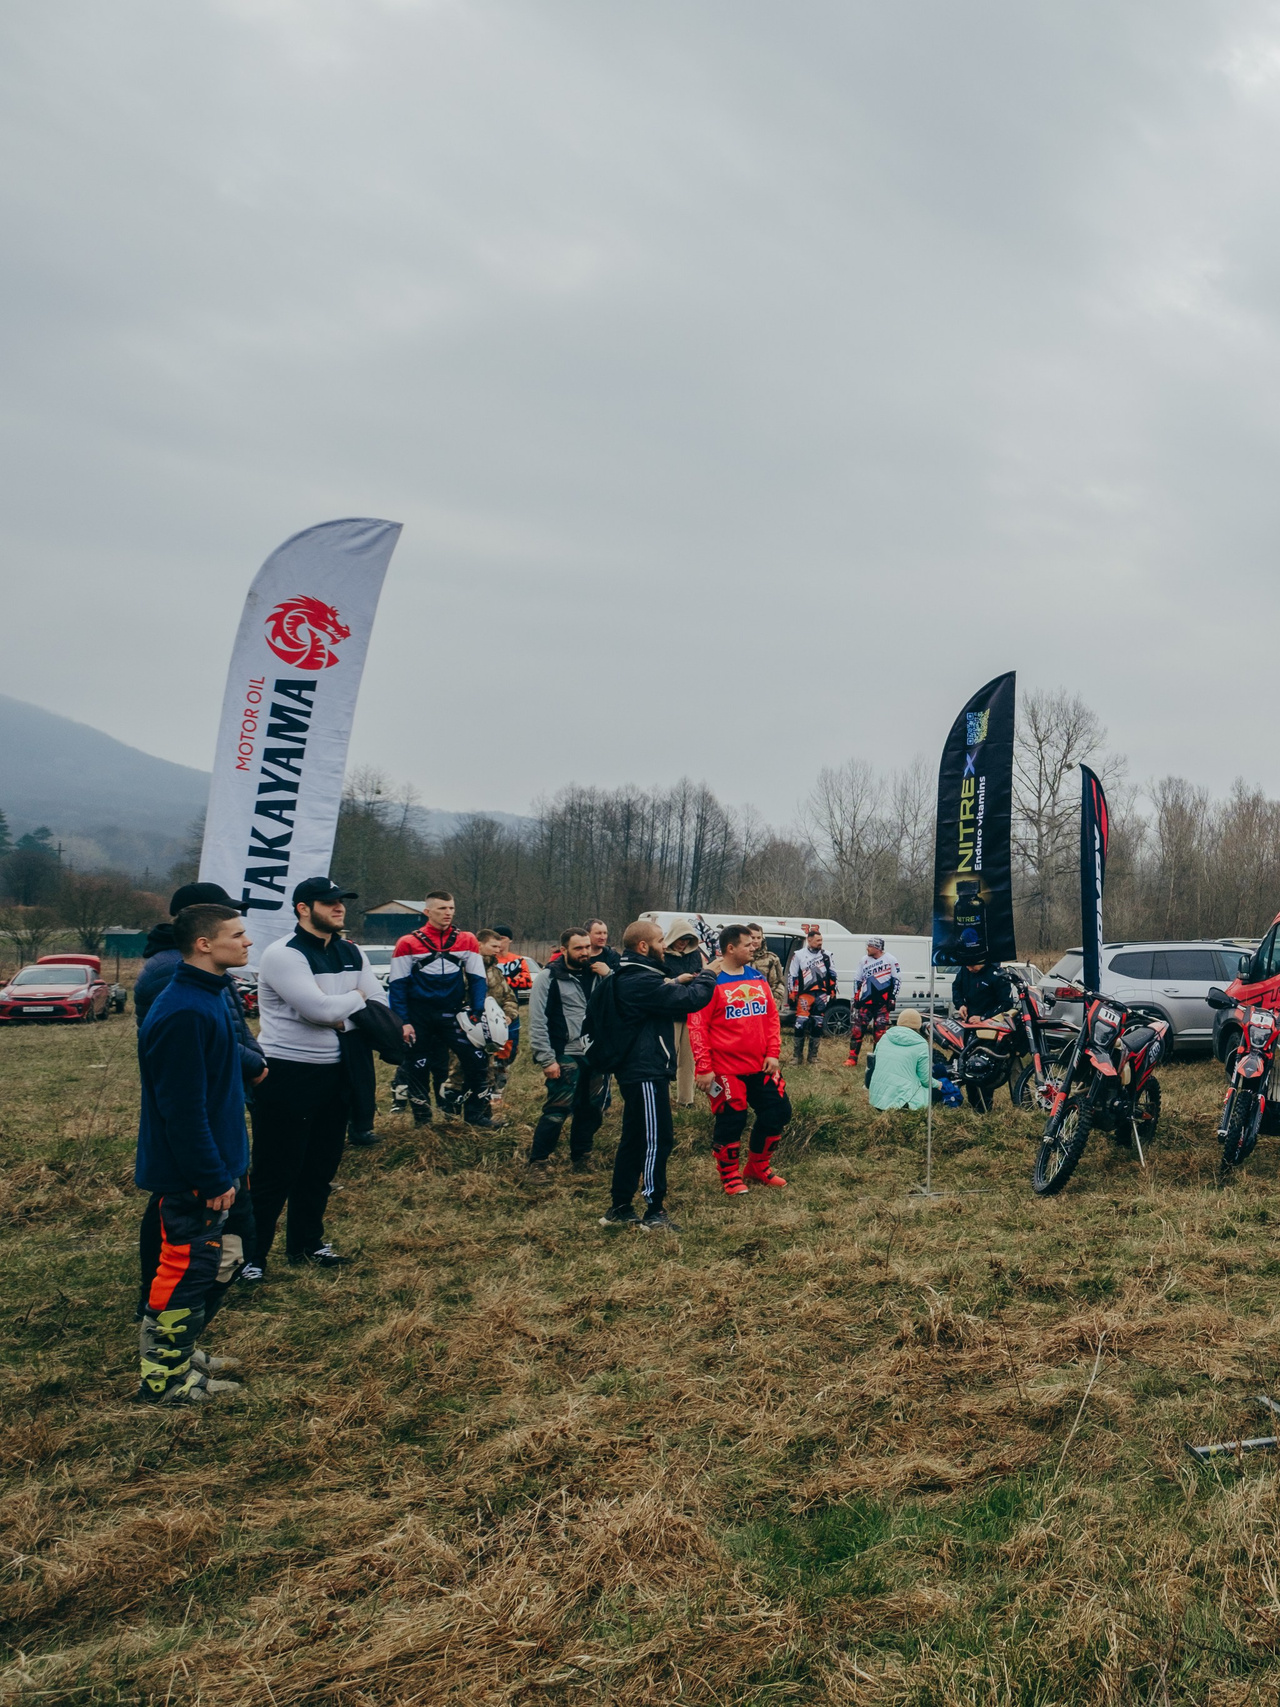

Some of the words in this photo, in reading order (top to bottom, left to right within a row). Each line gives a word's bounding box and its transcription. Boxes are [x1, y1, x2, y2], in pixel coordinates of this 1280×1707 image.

[246, 676, 265, 705] OIL
[235, 708, 260, 771] MOTOR
[241, 679, 318, 917] TAKAYAMA
[957, 752, 977, 873] NITREX
[976, 776, 986, 826] vitamins
[974, 829, 983, 871] Enduro
[725, 1003, 750, 1019] Red
